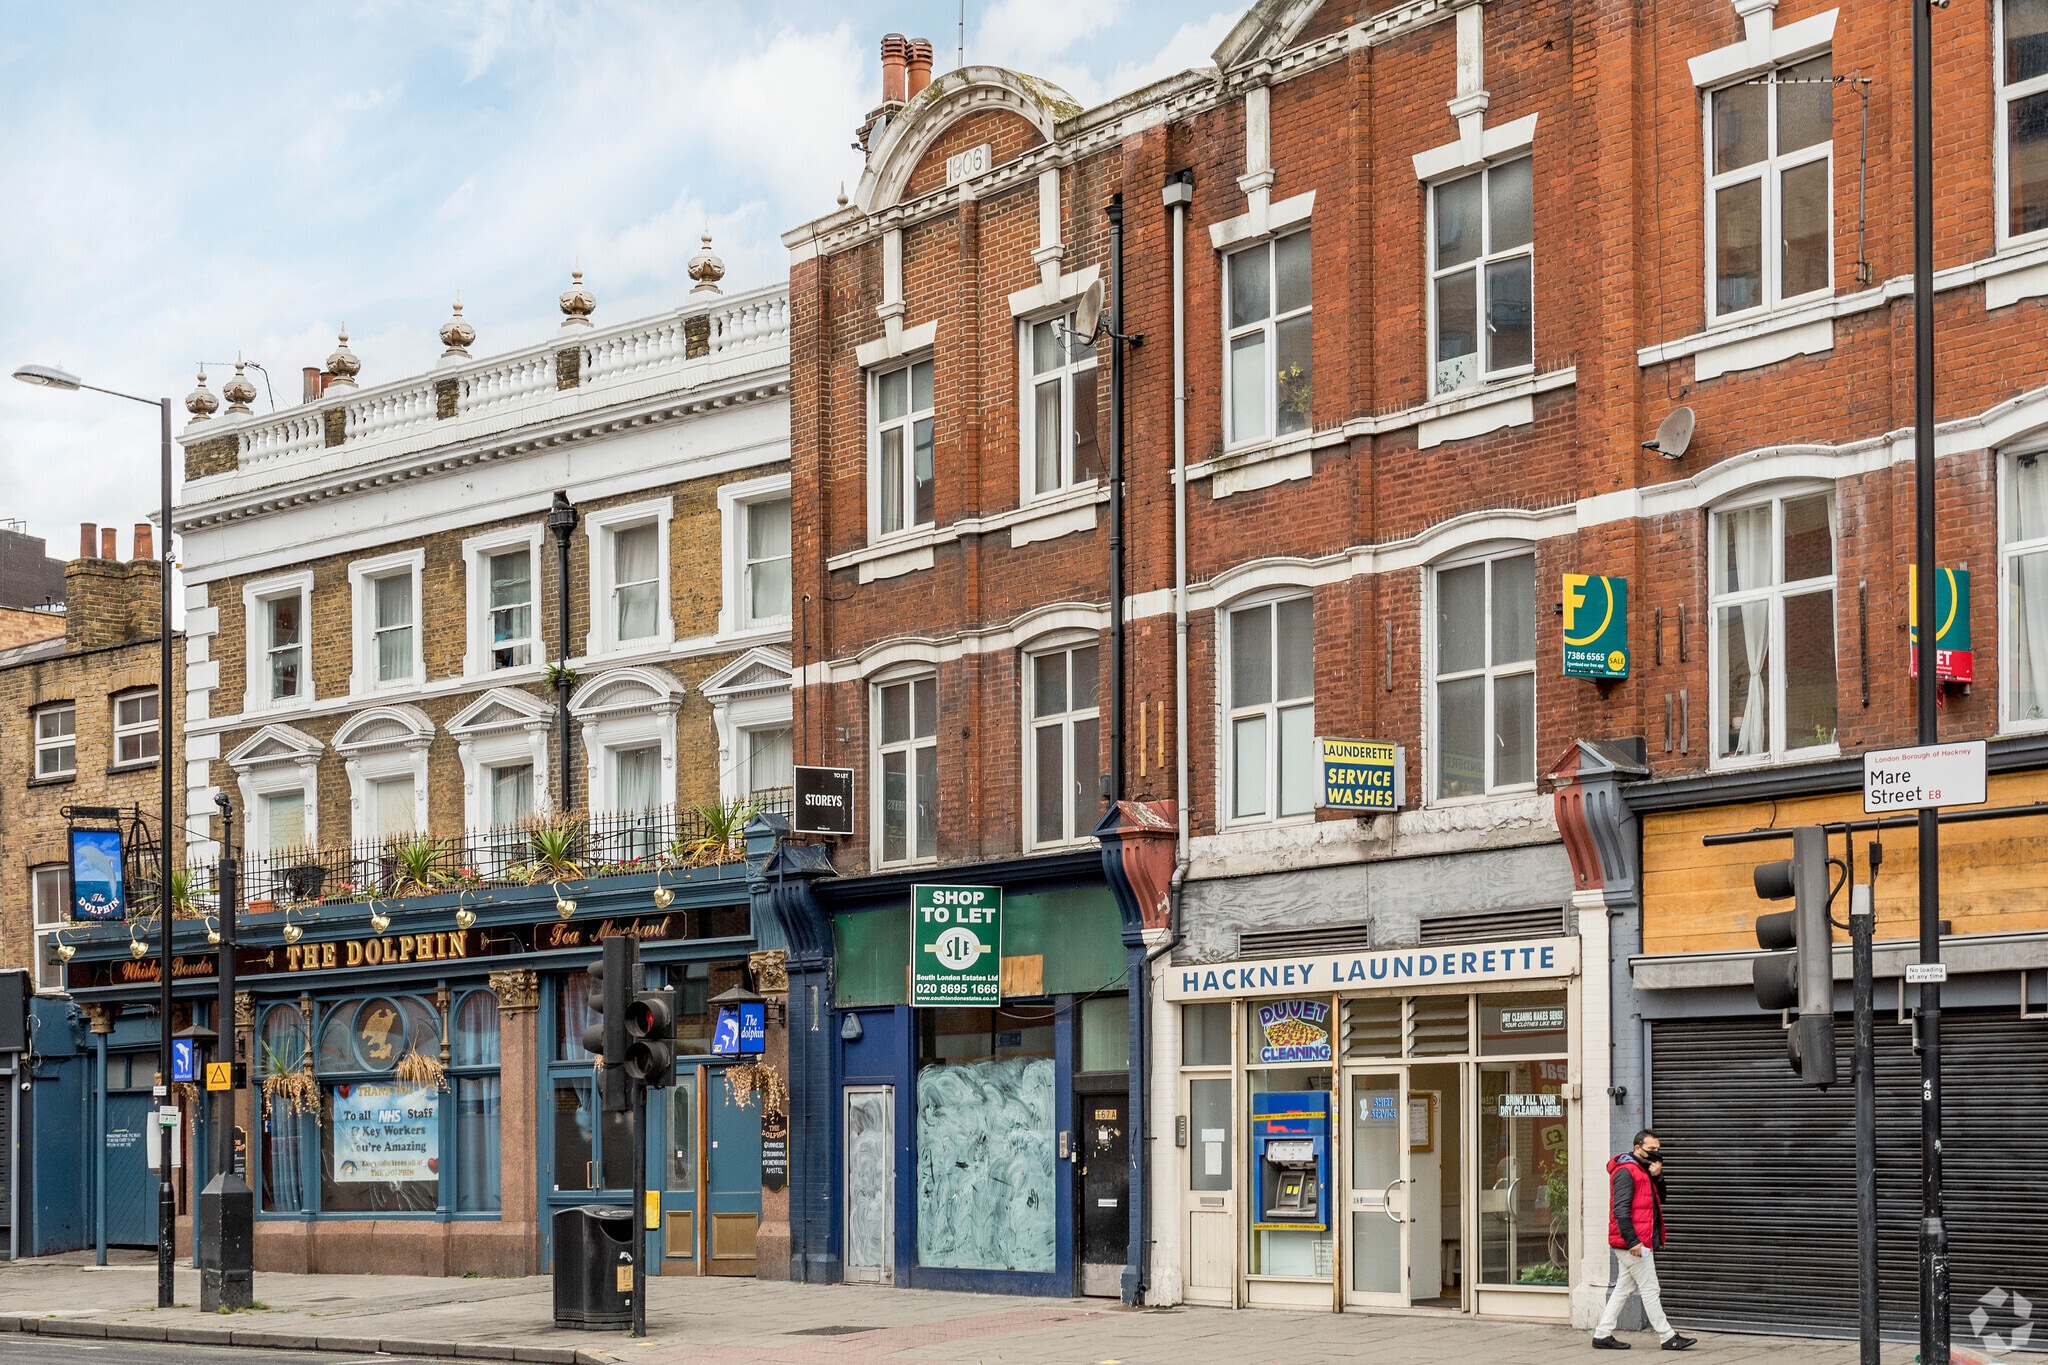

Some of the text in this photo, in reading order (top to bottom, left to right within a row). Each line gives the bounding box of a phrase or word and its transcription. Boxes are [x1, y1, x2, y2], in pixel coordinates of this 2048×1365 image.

[949, 148, 982, 182] 1906
[1567, 651, 1605, 661] 7386 6565
[1609, 657, 1624, 665] SALE
[1936, 650, 1952, 665] ET
[1323, 744, 1393, 760] LAUNDERETTE
[1902, 753, 1930, 761] Borough
[1327, 768, 1391, 786] SERVICE
[1870, 770, 1911, 785] Mare
[805, 794, 842, 807] STOREYS
[1327, 788, 1393, 806] WASHES
[1871, 786, 1942, 804] Street E8
[92, 893, 105, 902] The
[932, 891, 985, 905] SHOP
[78, 896, 120, 914] DOLPHIN
[920, 907, 996, 923] TO LET
[549, 923, 580, 946] Tea
[286, 930, 468, 972] THE DOLPHIN
[946, 937, 969, 960] SLE
[122, 959, 162, 983] Whisky
[1183, 946, 1554, 992] HACKNEY LAUNDERETTE
[916, 984, 998, 994] 020 8695 1666
[746, 1014, 757, 1026] The
[1258, 1000, 1330, 1026] DUVET
[1511, 1011, 1532, 1021] CLEANING
[1533, 1011, 1548, 1021] MAKES
[1549, 1010, 1563, 1020] SENSE
[741, 1026, 764, 1041] dolphin
[1261, 1045, 1331, 1062] CLEANING
[357, 1085, 392, 1097] THANK
[1373, 1098, 1393, 1107] SHIRT
[1505, 1095, 1556, 1105] BRING ALL YOUR
[344, 1108, 433, 1122] To all NHS Staff
[1096, 1110, 1116, 1119] 167A
[1371, 1109, 1397, 1118] SERVICE
[1500, 1106, 1561, 1116] DRY CLEANING HERE
[362, 1126, 381, 1137] Key
[384, 1125, 426, 1136] Workers
[761, 1129, 787, 1139] DOLPHIN
[384, 1141, 427, 1153] Amazing
